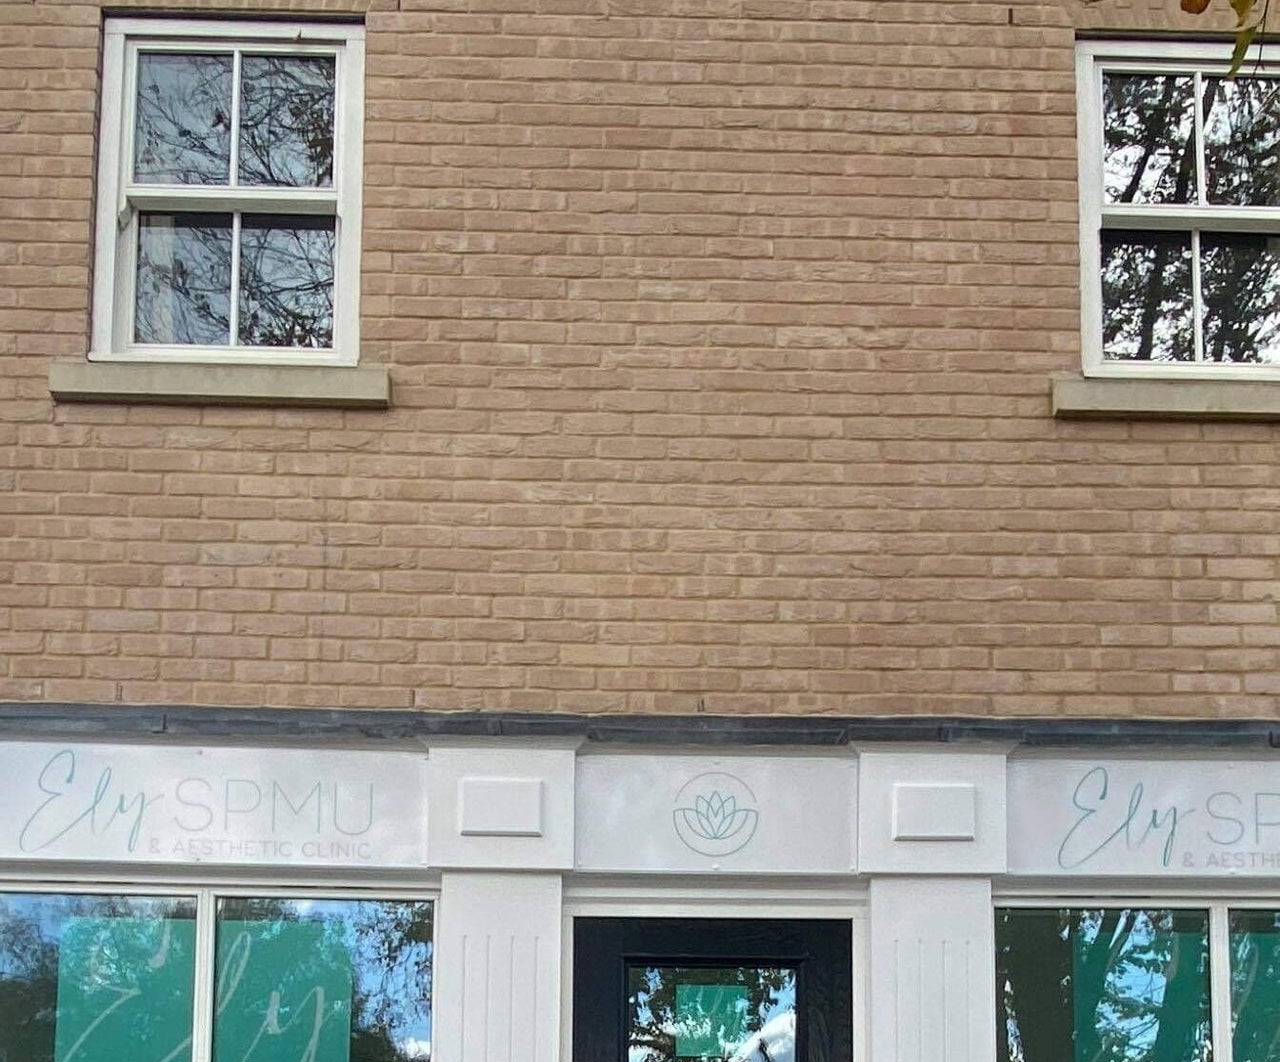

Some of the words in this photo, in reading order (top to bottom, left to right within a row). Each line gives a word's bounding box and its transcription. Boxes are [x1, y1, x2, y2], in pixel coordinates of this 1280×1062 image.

[20, 750, 164, 852] Ely
[174, 777, 374, 836] SPMU
[1058, 766, 1196, 870] Ely
[150, 838, 162, 855] &
[172, 838, 294, 858] AESTHETIC
[300, 841, 372, 860] CLINIC
[1182, 852, 1195, 868] &
